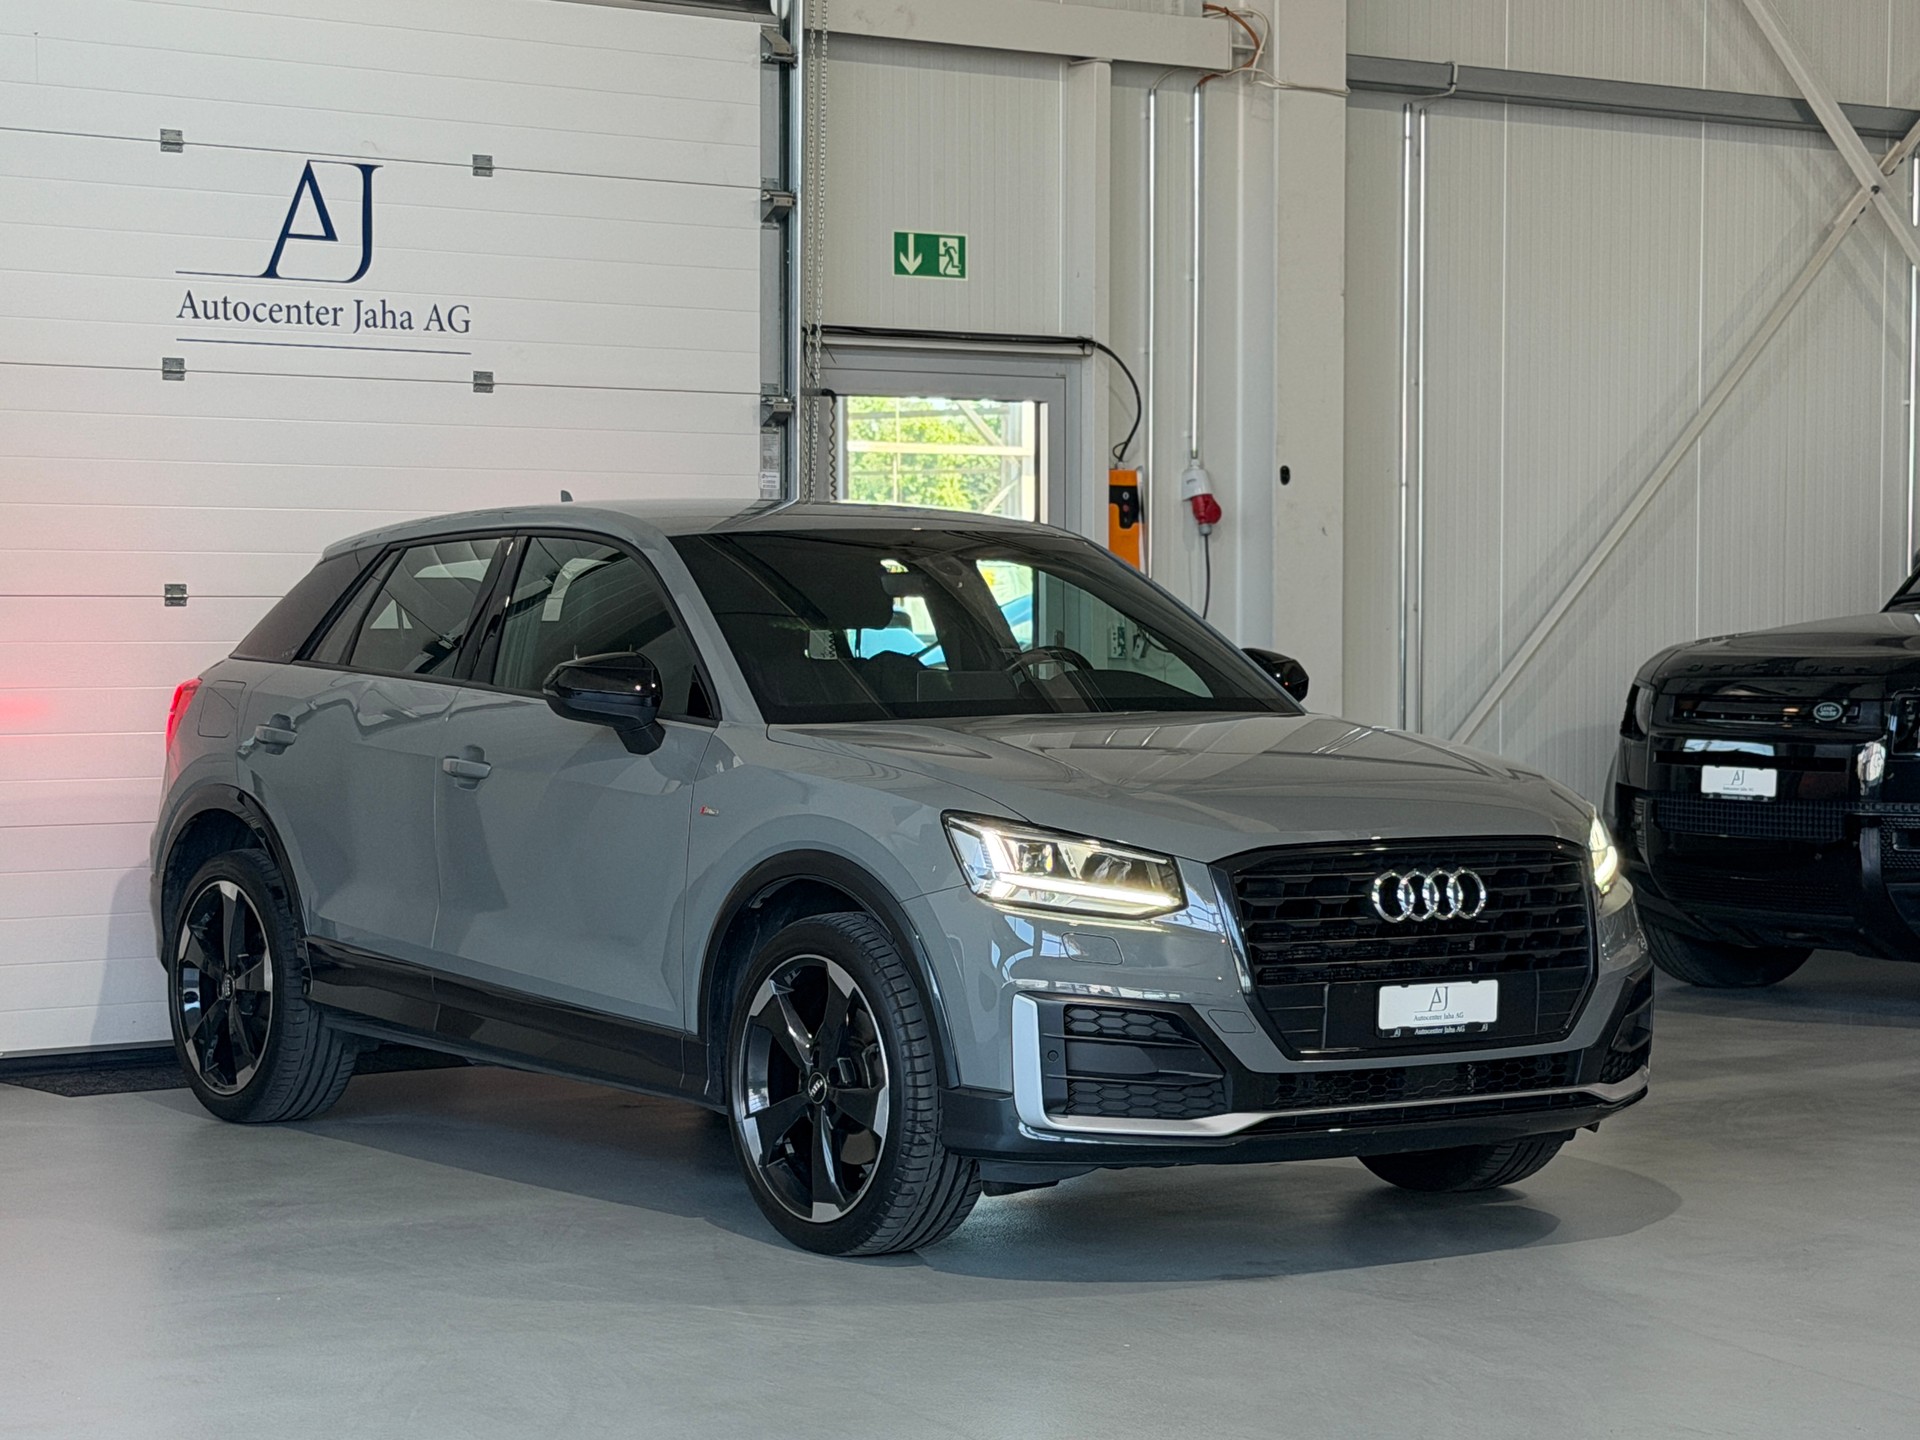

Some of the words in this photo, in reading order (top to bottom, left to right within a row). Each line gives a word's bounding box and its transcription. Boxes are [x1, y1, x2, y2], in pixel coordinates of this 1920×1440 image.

[258, 159, 383, 283] AJ
[176, 290, 344, 326] Autocenter
[352, 299, 414, 334] Jaha
[423, 303, 471, 333] AG
[1731, 769, 1745, 786] AJ
[1429, 986, 1449, 1011] AJ
